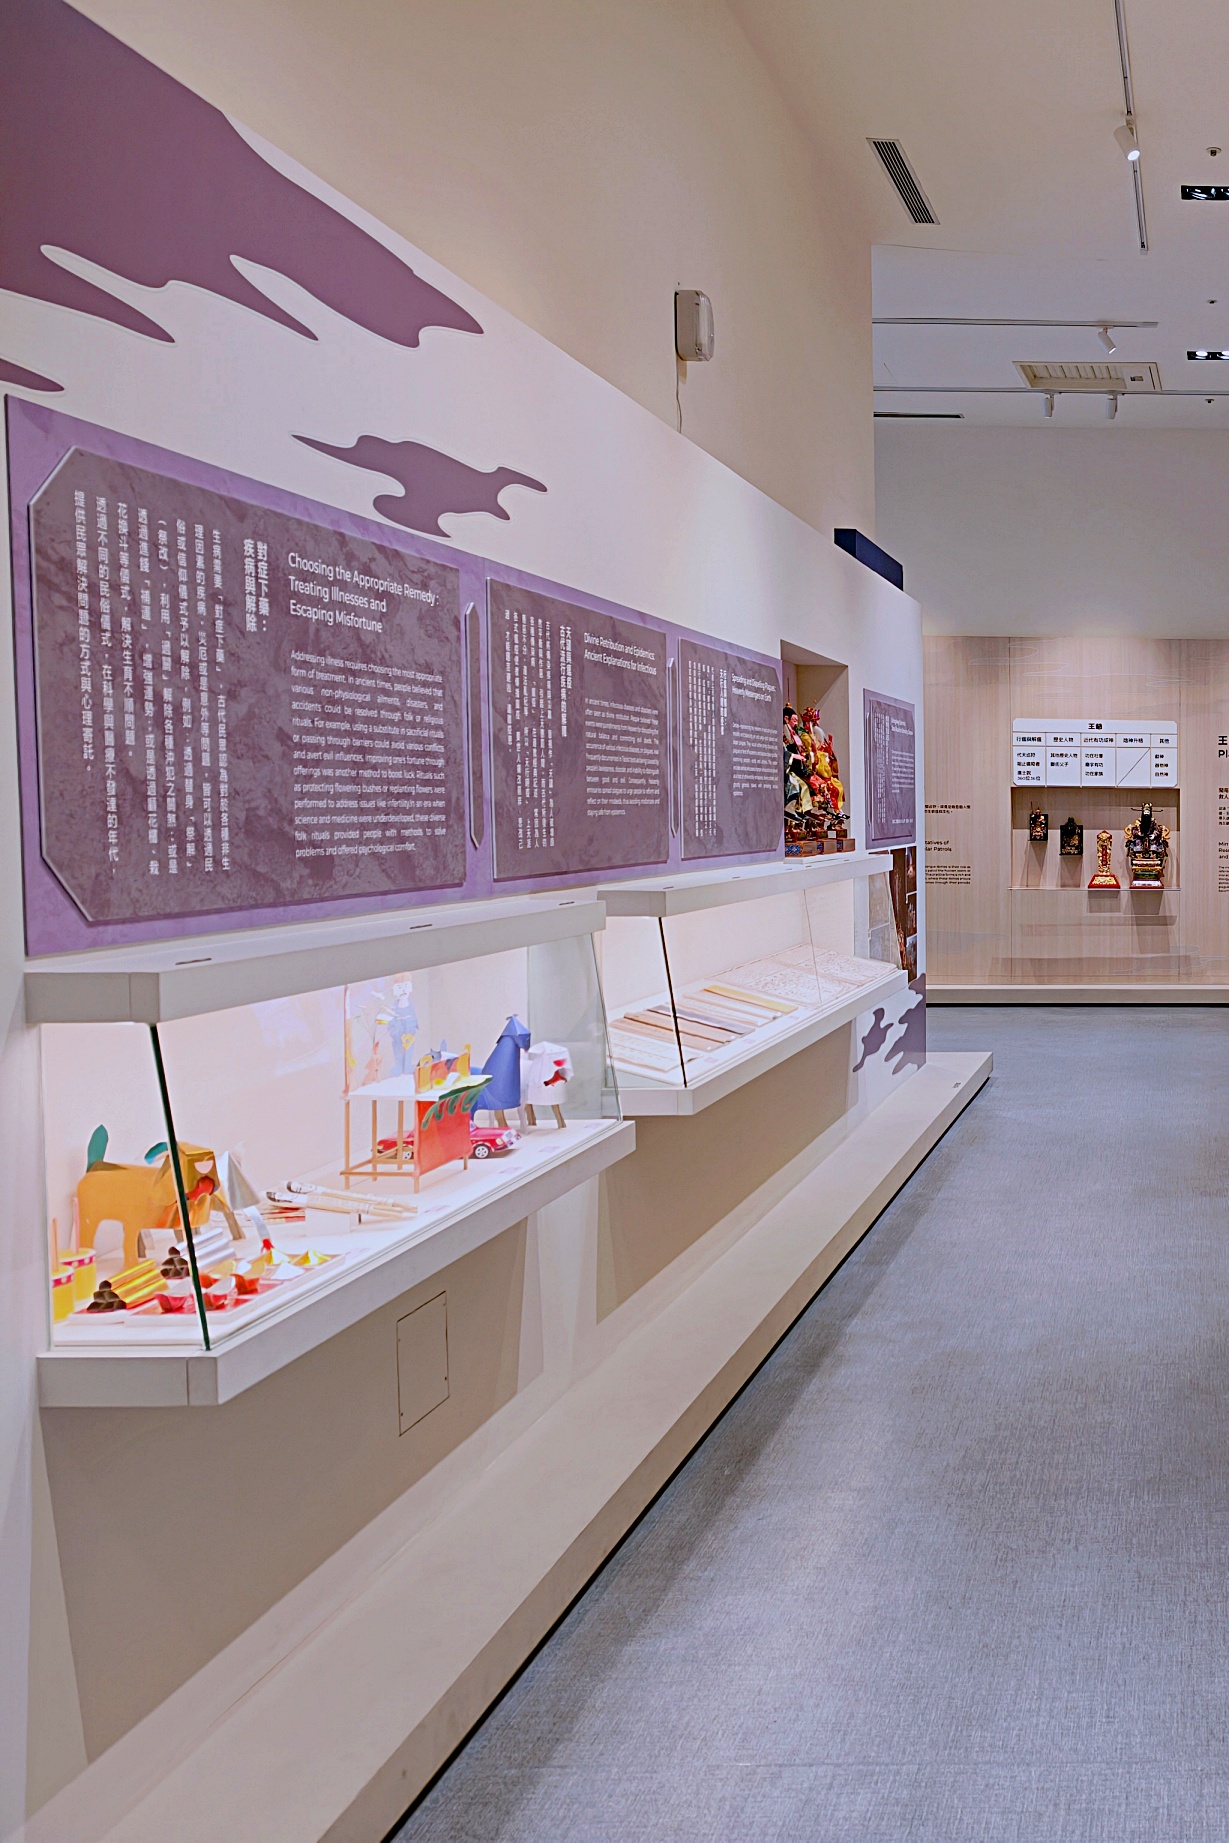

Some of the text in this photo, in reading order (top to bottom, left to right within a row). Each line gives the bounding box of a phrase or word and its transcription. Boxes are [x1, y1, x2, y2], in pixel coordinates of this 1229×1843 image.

[288, 552, 334, 581] Choosing
[335, 565, 351, 582] the
[352, 570, 403, 595] Appropriate
[288, 575, 387, 612] Treating Illnesses and
[290, 600, 383, 633] Escaping Misfortune
[583, 632, 600, 646] Divine
[624, 645, 633, 655] and
[290, 650, 325, 666] Addressing
[583, 648, 602, 663] Ancient
[290, 665, 306, 676] form
[307, 668, 315, 678] of
[291, 684, 314, 694] various
[291, 701, 321, 711] accidents
[324, 704, 341, 713] could
[343, 705, 352, 714] be
[313, 717, 324, 727] For
[292, 733, 350, 747] or passing through
[292, 749, 306, 758] and
[306, 751, 322, 759] avert
[321, 768, 333, 776] was
[334, 767, 357, 776] another
[293, 783, 301, 791] as
[302, 782, 334, 794] protecting
[294, 797, 326, 808] performed
[327, 799, 334, 807] to
[294, 816, 318, 824] science
[318, 814, 330, 823] and
[294, 829, 359, 840] folk rituals provided
[295, 845, 336, 857] problems and
